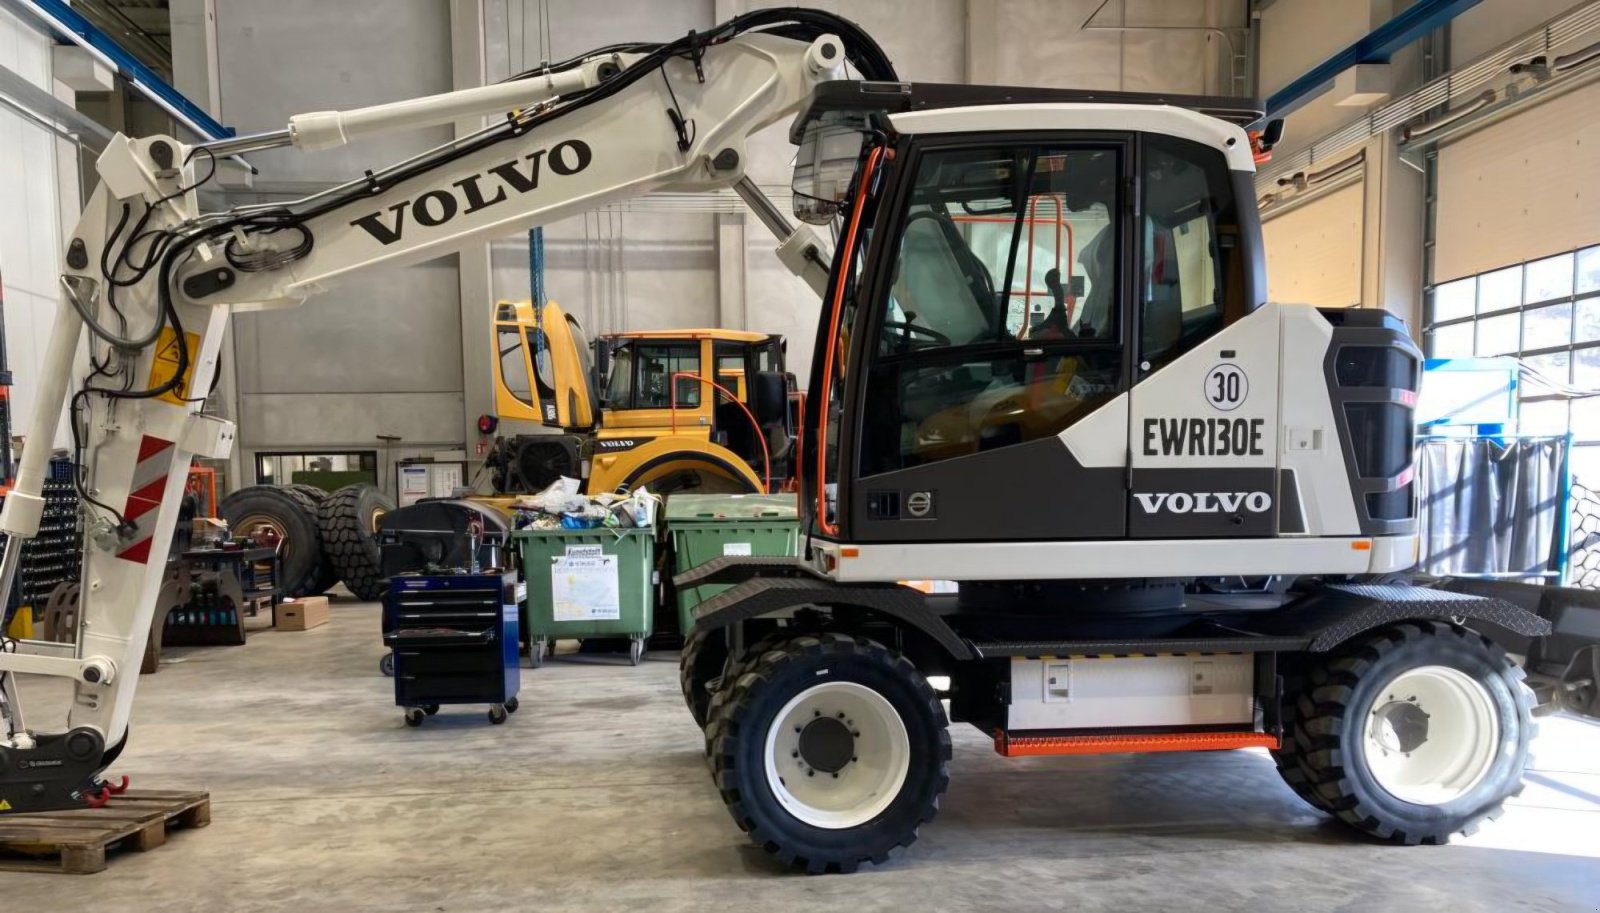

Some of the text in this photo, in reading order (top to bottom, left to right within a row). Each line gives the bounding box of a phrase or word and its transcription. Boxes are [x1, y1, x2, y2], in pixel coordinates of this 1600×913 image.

[350, 139, 592, 245] VOLVO
[1213, 372, 1240, 403] 30
[1143, 418, 1265, 456] EWR130E
[1133, 491, 1272, 514] VOLVO
